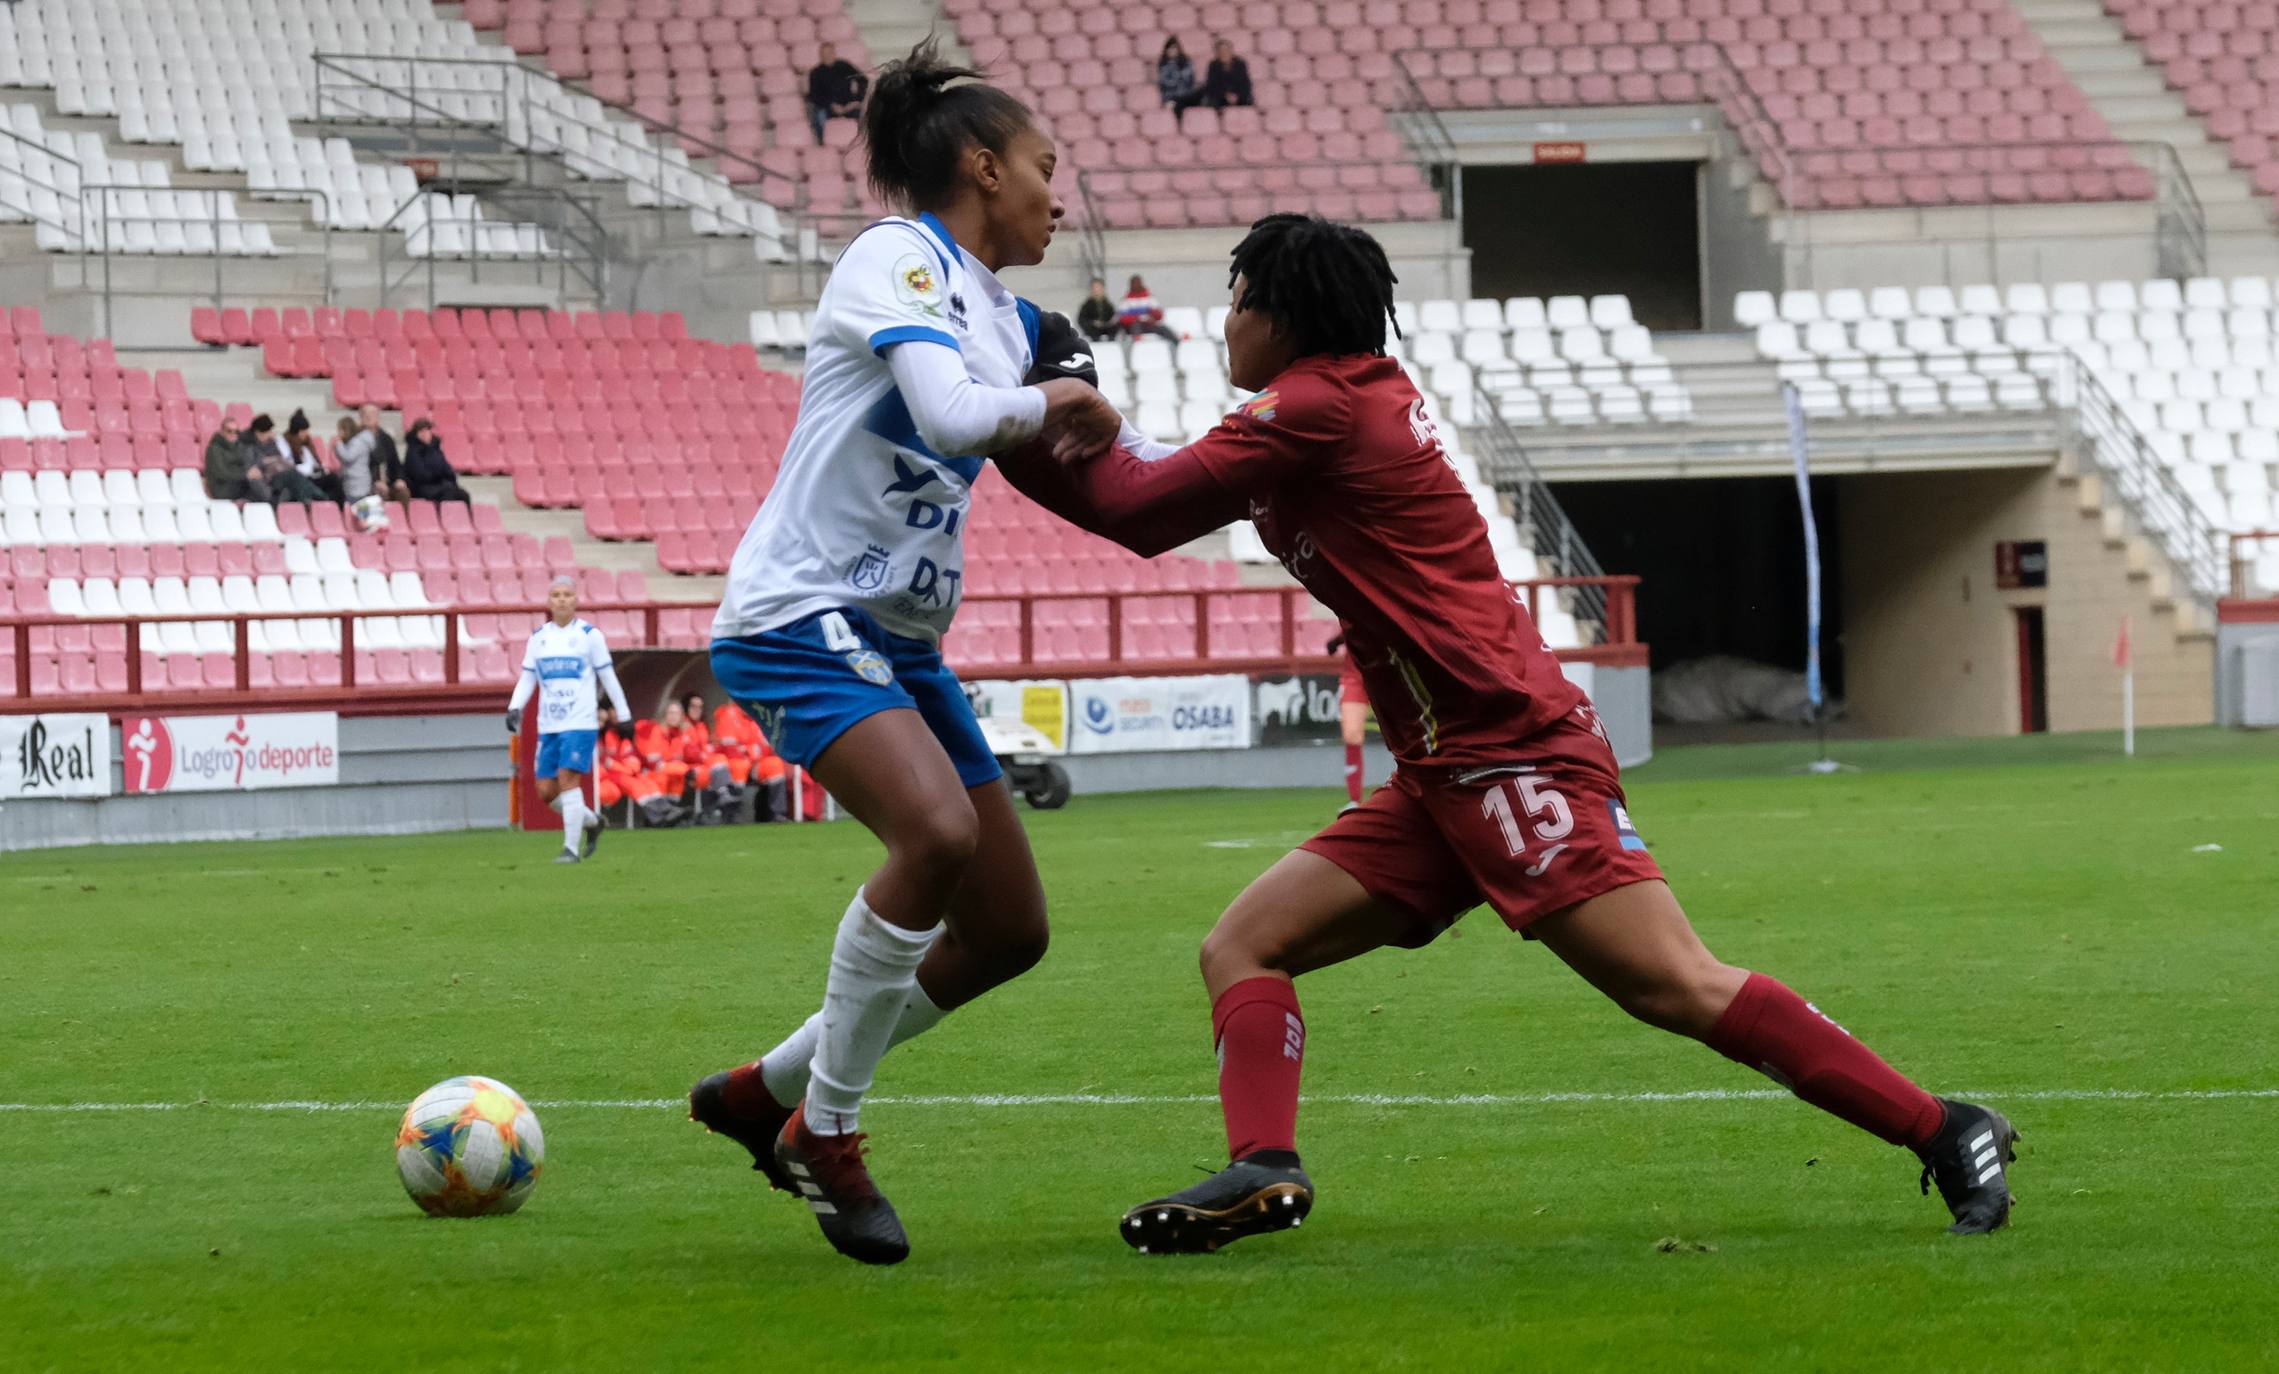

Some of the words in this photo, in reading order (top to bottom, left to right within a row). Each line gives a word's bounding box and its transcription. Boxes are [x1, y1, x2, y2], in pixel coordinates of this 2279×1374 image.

[18, 714, 95, 792] Real
[1173, 706, 1233, 730] OSABA
[1482, 775, 1574, 857] 15
